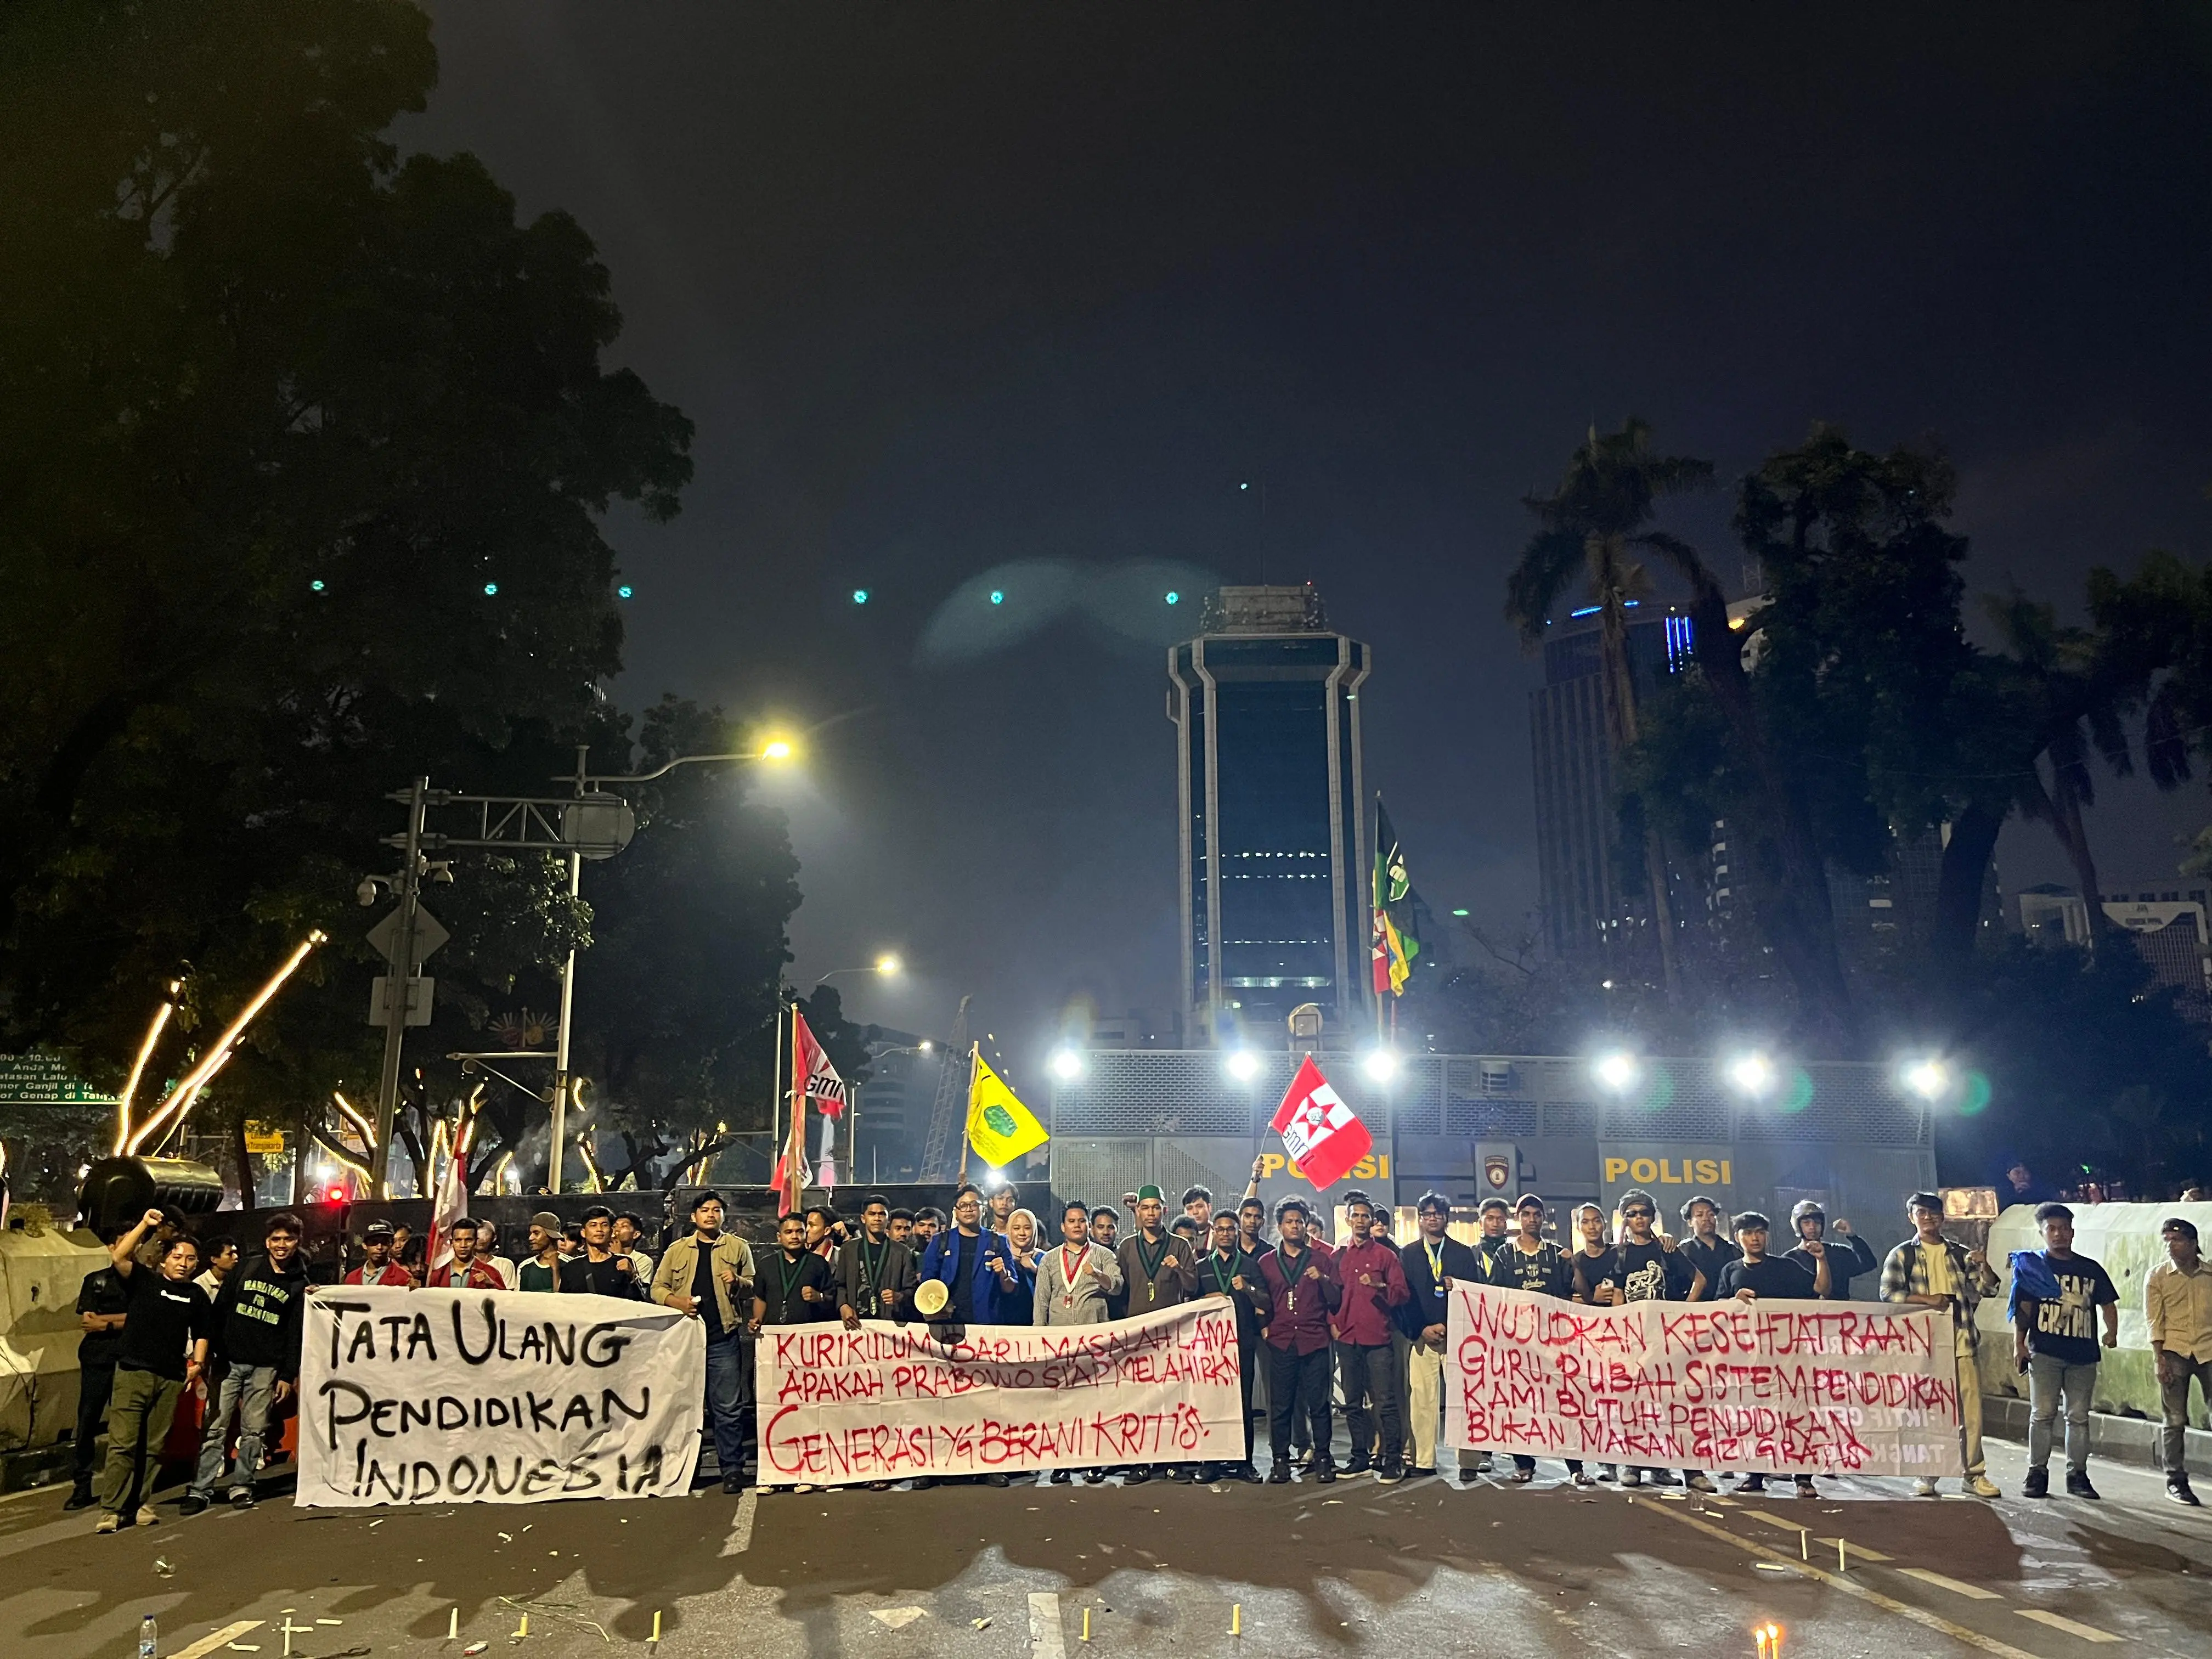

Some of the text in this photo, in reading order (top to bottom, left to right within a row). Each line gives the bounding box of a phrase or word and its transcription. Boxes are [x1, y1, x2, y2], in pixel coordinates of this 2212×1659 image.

[20, 1092, 58, 1101] Genap
[25, 1082, 58, 1091] Ganjil
[1605, 1158, 1731, 1184] POLISI
[312, 1298, 630, 1369] TATA ULANG
[776, 1331, 933, 1369] KURIKULUM
[1041, 1325, 1171, 1368] MASALAH
[1177, 1318, 1238, 1356] LAMA
[1462, 1290, 1646, 1356] WUJUDKAN
[778, 1368, 883, 1403] APAKAH
[891, 1364, 1034, 1398] PRABOWO
[1042, 1360, 1110, 1388] SIAP
[1555, 1351, 1677, 1401] RUBAH
[1684, 1360, 1809, 1406] SISTEM
[1813, 1367, 1957, 1427] PENDIDIKAN
[318, 1379, 650, 1451] PENDIDIKAN
[766, 1404, 934, 1480] GENERASI
[979, 1417, 1082, 1465] BERANI
[1464, 1378, 1545, 1415] KAMI
[1556, 1388, 1661, 1430] BUTUH
[1668, 1402, 1872, 1457] PENDIDIKAN
[1468, 1410, 1565, 1452] BUKAN
[1579, 1419, 1685, 1460] MAKAN
[351, 1438, 663, 1502] INDONESIA
